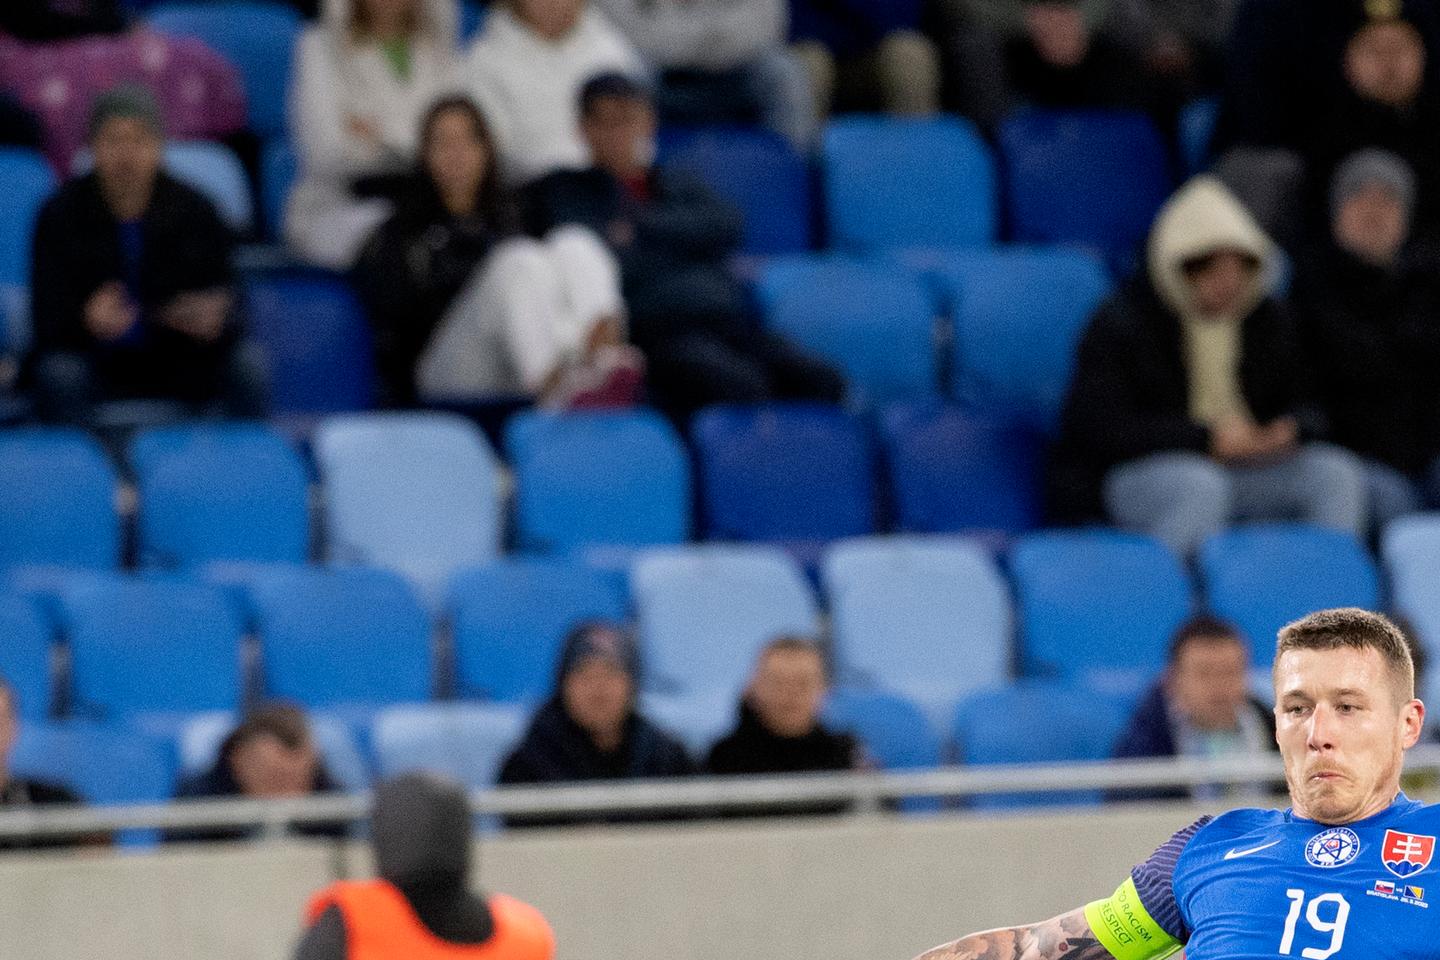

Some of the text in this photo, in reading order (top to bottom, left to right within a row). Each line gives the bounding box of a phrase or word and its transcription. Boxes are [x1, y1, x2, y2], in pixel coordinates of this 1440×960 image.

[1101, 902, 1134, 945] RESPECT
[1121, 903, 1153, 942] RACISM
[1279, 887, 1351, 960] 19
